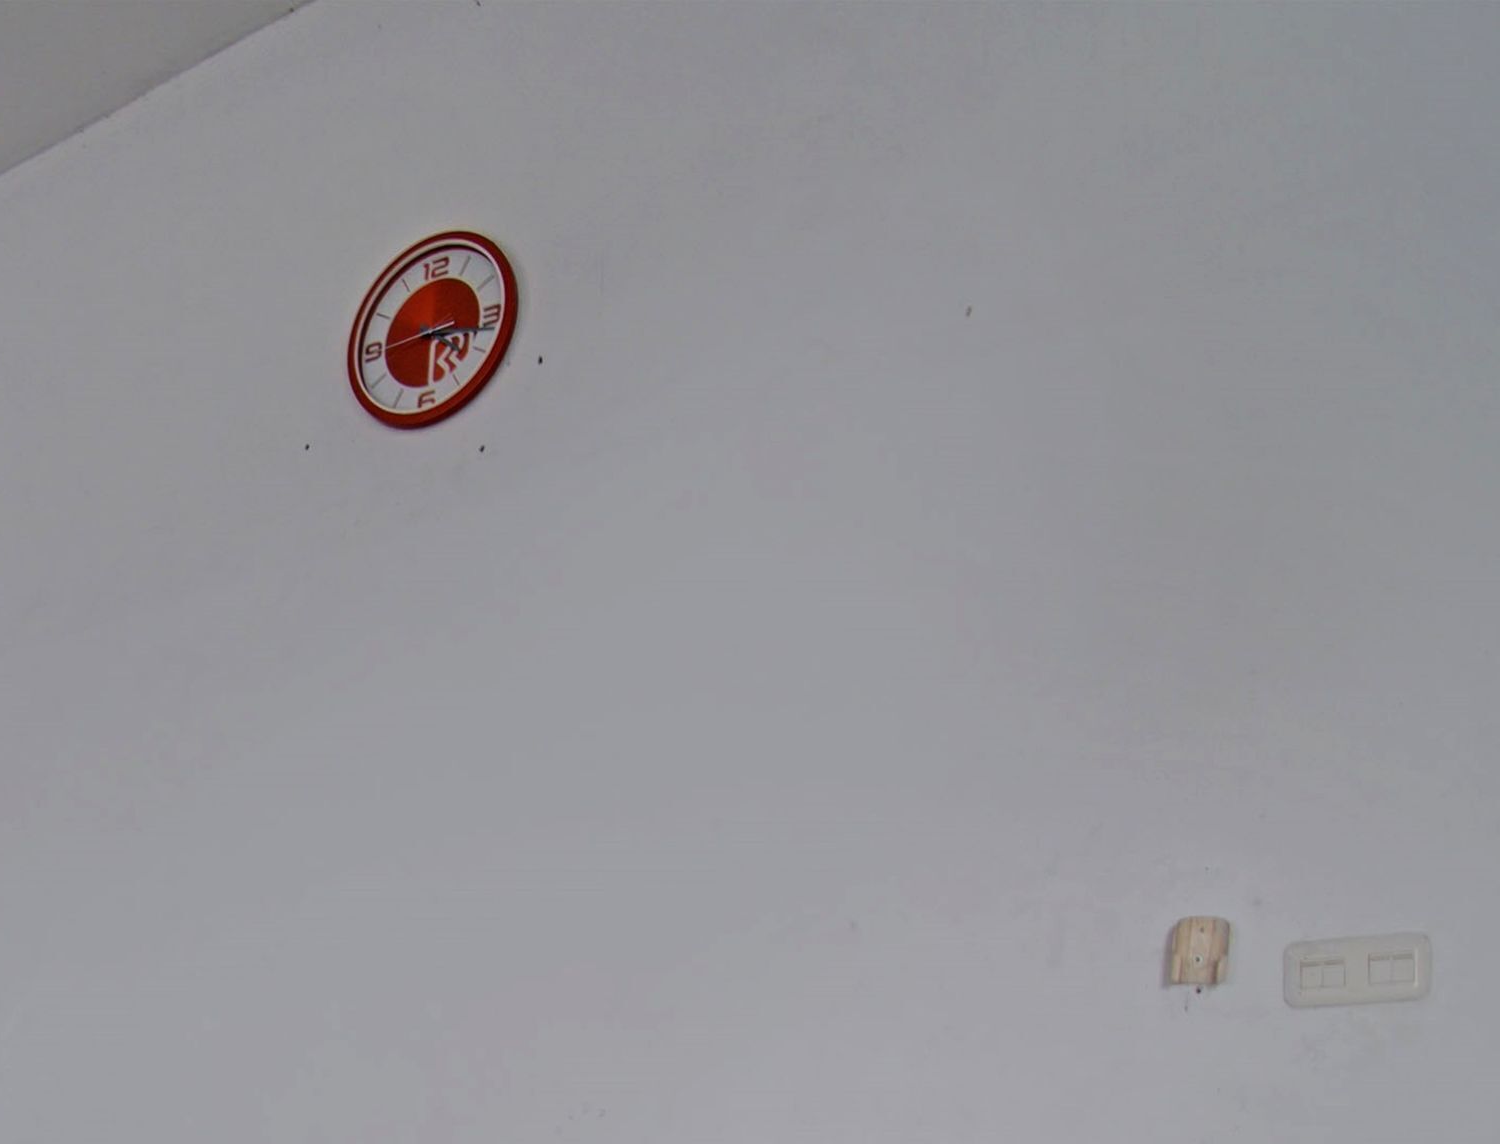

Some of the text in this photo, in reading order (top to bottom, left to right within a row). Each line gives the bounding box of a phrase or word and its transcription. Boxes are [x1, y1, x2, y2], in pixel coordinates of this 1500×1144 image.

[423, 256, 450, 280] 12
[483, 303, 501, 327] 3
[364, 341, 382, 363] 9
